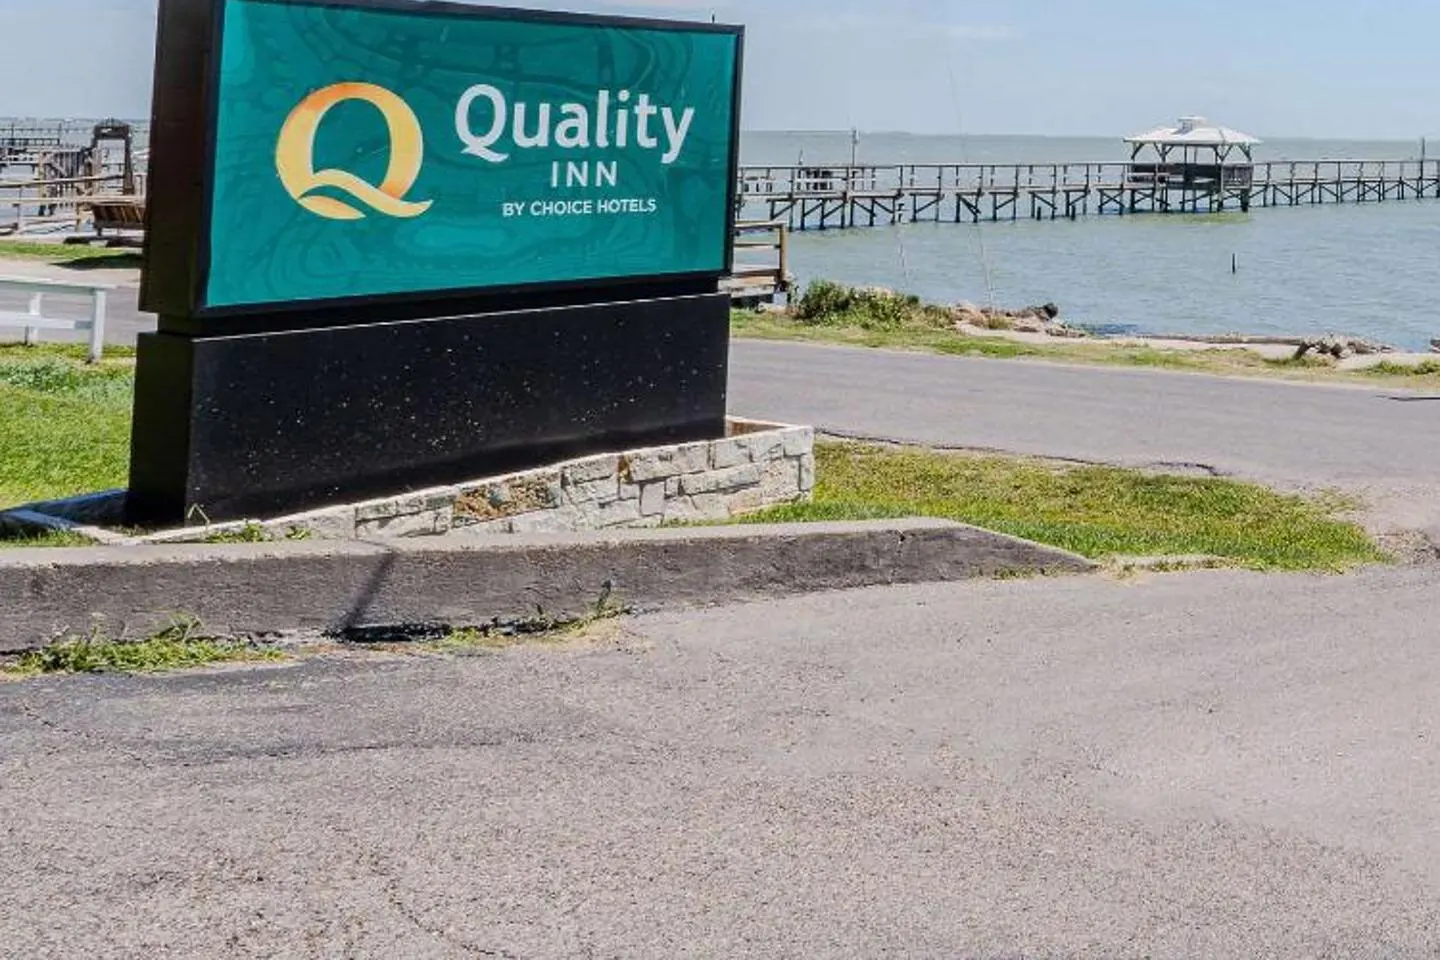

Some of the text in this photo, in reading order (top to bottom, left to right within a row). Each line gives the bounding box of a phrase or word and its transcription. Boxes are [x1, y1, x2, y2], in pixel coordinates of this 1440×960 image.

[275, 81, 433, 220] Q
[454, 83, 696, 164] Quality
[551, 161, 617, 188] INN
[502, 199, 657, 217] BY CHOICE HOTELS
